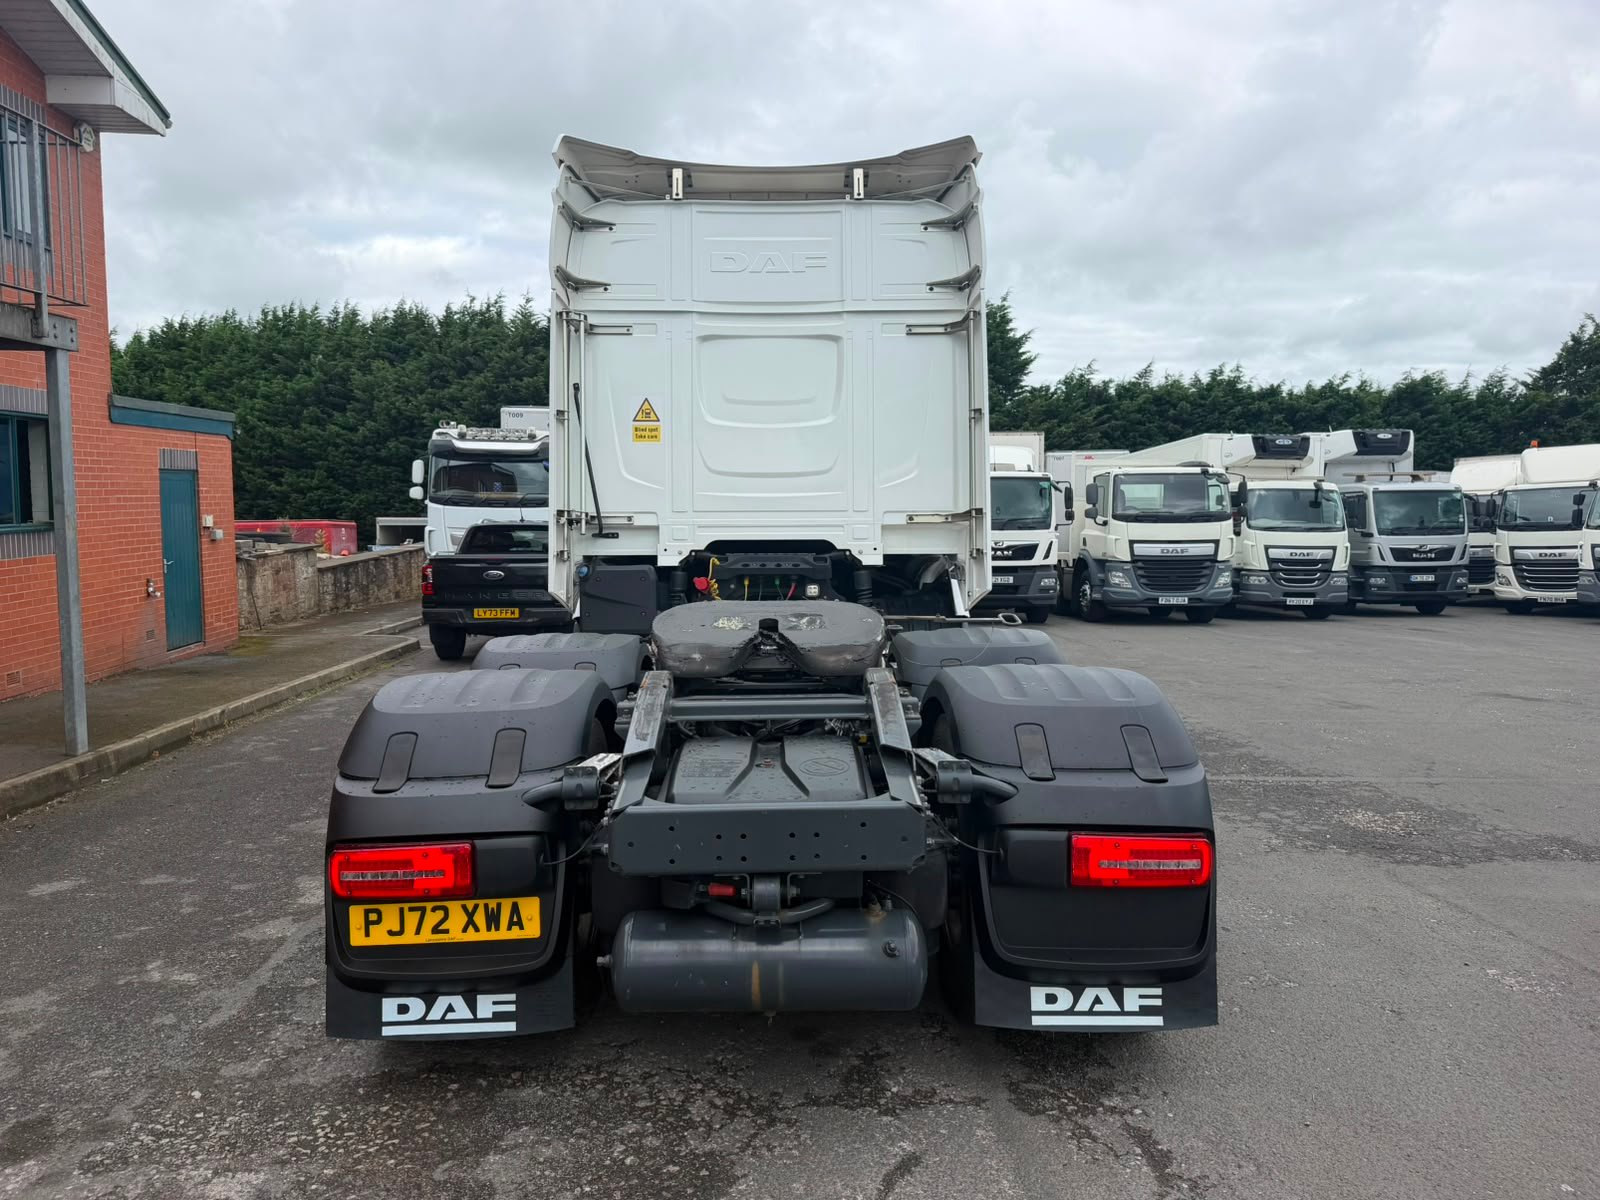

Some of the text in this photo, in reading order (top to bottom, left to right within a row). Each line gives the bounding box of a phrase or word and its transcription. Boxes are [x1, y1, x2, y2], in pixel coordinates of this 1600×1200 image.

[710, 251, 827, 273] DAF
[477, 609, 498, 617] LY73
[363, 901, 525, 938] PJ72 XWA
[381, 994, 517, 1022] DAF
[1030, 986, 1163, 1012] DAF
